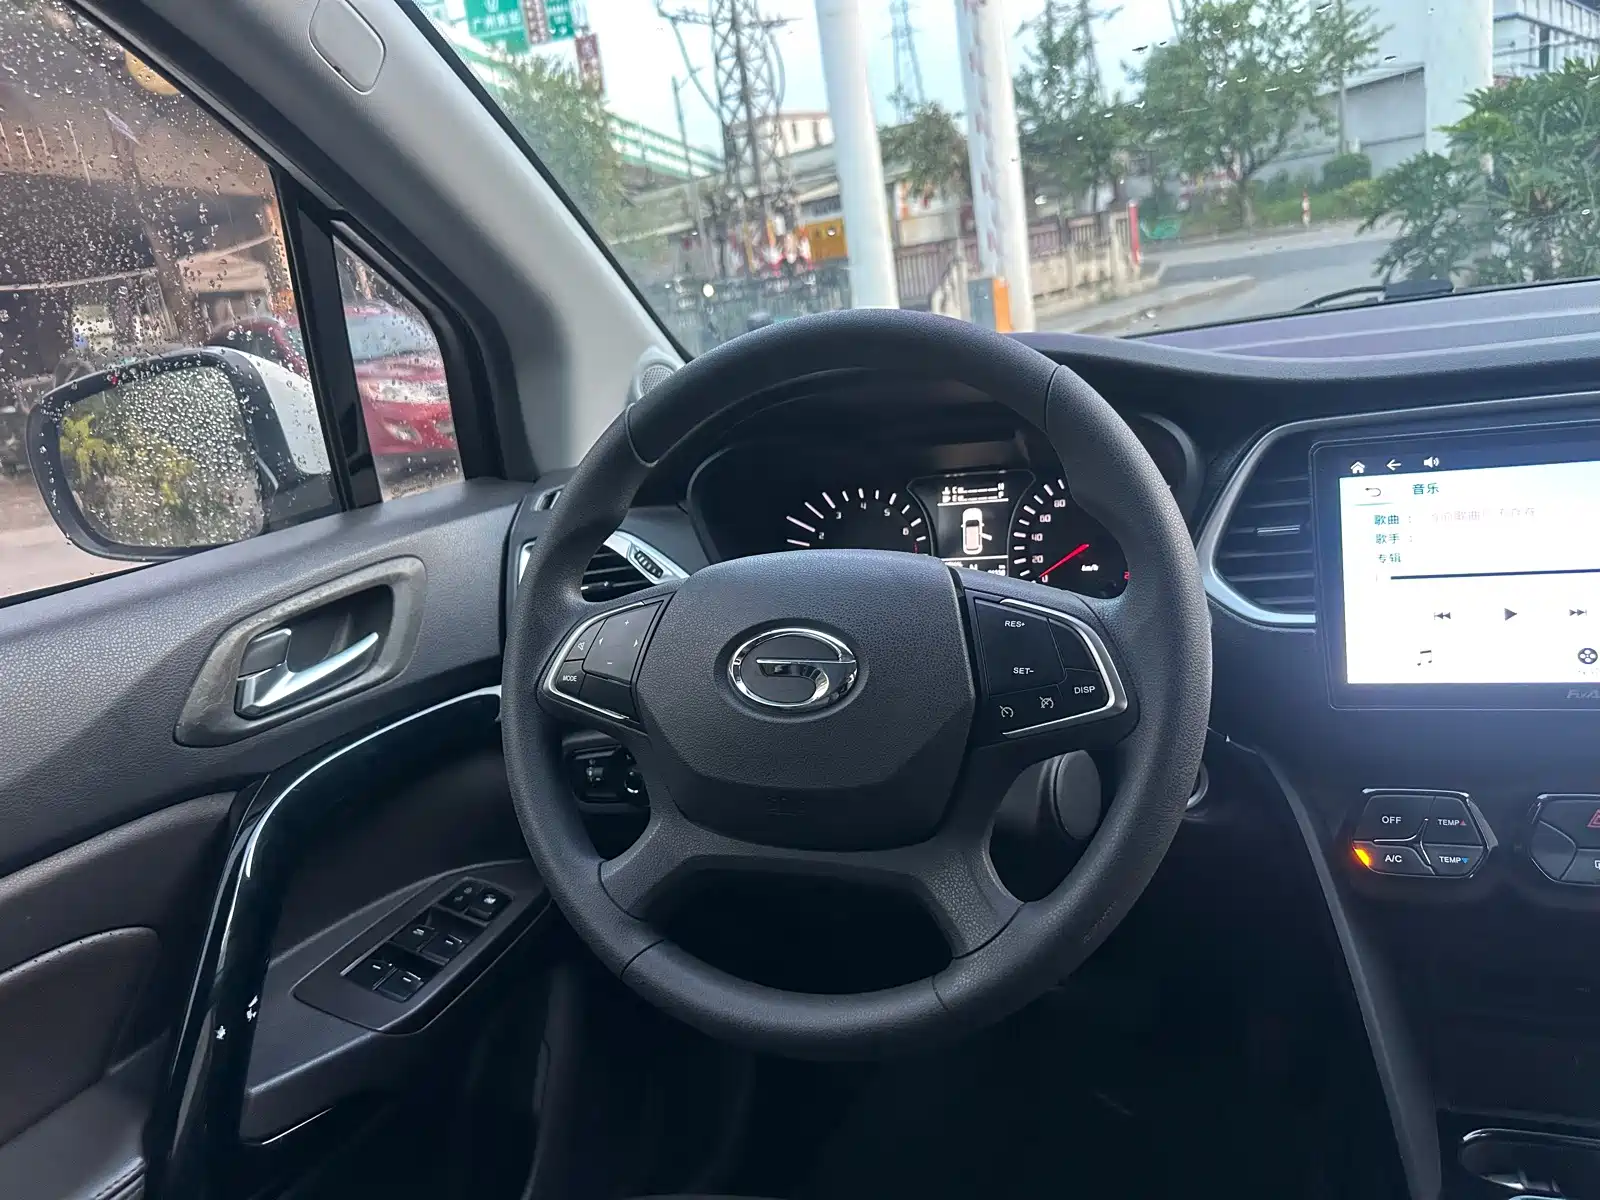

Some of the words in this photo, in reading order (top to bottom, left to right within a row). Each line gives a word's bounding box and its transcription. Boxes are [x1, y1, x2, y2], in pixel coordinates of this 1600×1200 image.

[1412, 482, 1440, 496] 音乐
[860, 502, 867, 510] 4
[1053, 498, 1066, 508] 80
[835, 511, 842, 520] 3
[883, 508, 891, 517] 5
[1039, 513, 1052, 523] 60
[818, 531, 825, 540] 2
[902, 527, 910, 536] 6
[1031, 533, 1044, 542] 40
[1031, 555, 1044, 564] 20
[1004, 619, 1026, 628] RES+
[1073, 685, 1096, 695] DISP
[1381, 815, 1402, 824] OFF
[1437, 818, 1459, 826] TEMP
[1384, 854, 1403, 863] A/C
[1439, 855, 1461, 864] TEMP
